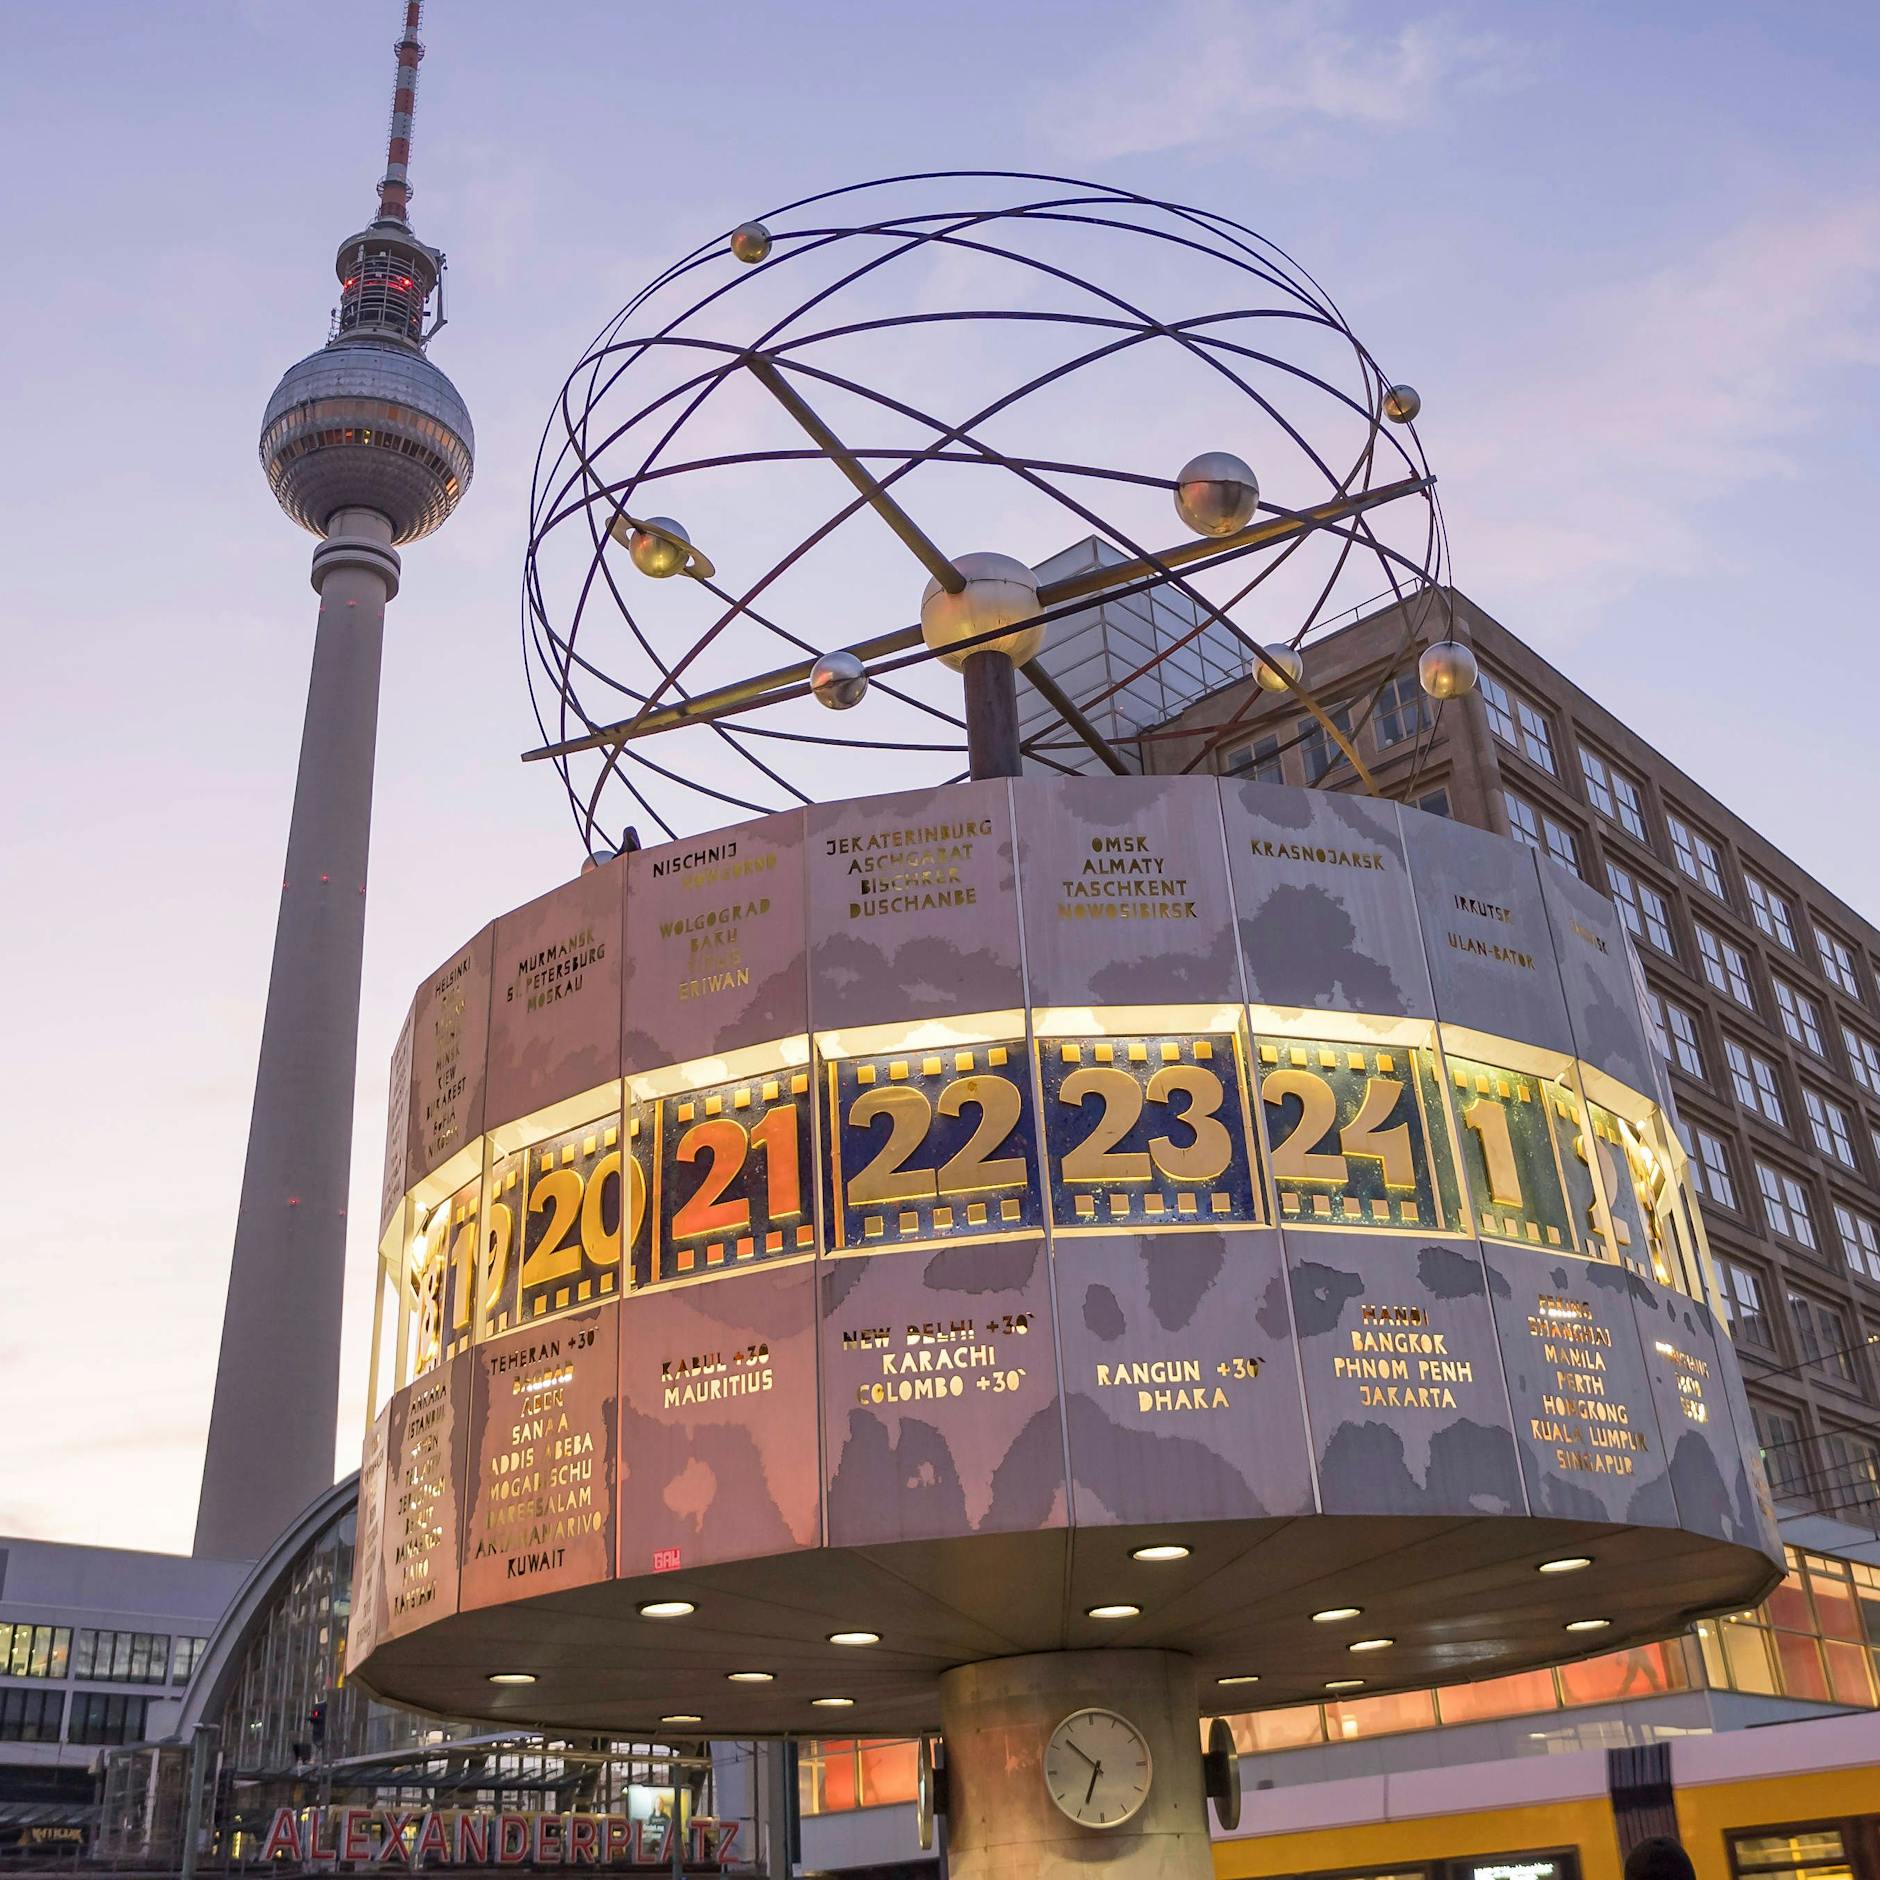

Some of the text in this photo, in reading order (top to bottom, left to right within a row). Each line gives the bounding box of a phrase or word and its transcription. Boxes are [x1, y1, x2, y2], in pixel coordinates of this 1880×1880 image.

[826, 820, 992, 855] JEKATERINBURG
[1091, 836, 1149, 852] OMSK
[653, 842, 737, 878] NISCHNIJ
[1082, 858, 1164, 874] ALMATY
[1251, 839, 1385, 871] KRASNOJARSK
[849, 888, 977, 919] DUSCHANBE
[1063, 879, 1187, 897] TASCHKENT
[659, 899, 770, 939] WOLGOGRAD
[1056, 902, 1197, 920] NOWOSIBIRSK
[519, 928, 594, 976] MURMANSK
[526, 943, 605, 992] PETERSBURG
[435, 955, 471, 995] HELSINKI
[678, 967, 750, 1001] ERIWAN
[527, 974, 583, 1013] MOSKAU
[1060, 1065, 1232, 1182] 23
[1262, 1069, 1416, 1190] 24
[847, 1075, 1027, 1206] 22
[672, 1102, 801, 1240] 21
[522, 1150, 646, 1289] 20
[1361, 1304, 1429, 1326] HANOI
[843, 1326, 891, 1350] NEW
[907, 1319, 975, 1345] DELHI
[1351, 1331, 1449, 1355] BANGKOK
[491, 1340, 560, 1375] TEHERAN
[661, 1352, 727, 1382] KABUL
[882, 1345, 996, 1375] KARACHI
[1097, 1360, 1200, 1386] RANGUN
[1334, 1357, 1473, 1383] PHNOM PENH
[1544, 1344, 1606, 1371] MANILA
[664, 1368, 773, 1408] MAURITIUS
[857, 1375, 964, 1405] COLOMBO
[1360, 1385, 1458, 1409] JAKARTA
[1557, 1371, 1605, 1396] PERTH
[1138, 1387, 1230, 1413] DHAKA
[1530, 1419, 1582, 1444] KUALA
[491, 1432, 594, 1476] ADDIS ABEBA
[508, 1549, 565, 1579] KUWAIT
[262, 1807, 743, 1866] ALEXANDERPLATZ
